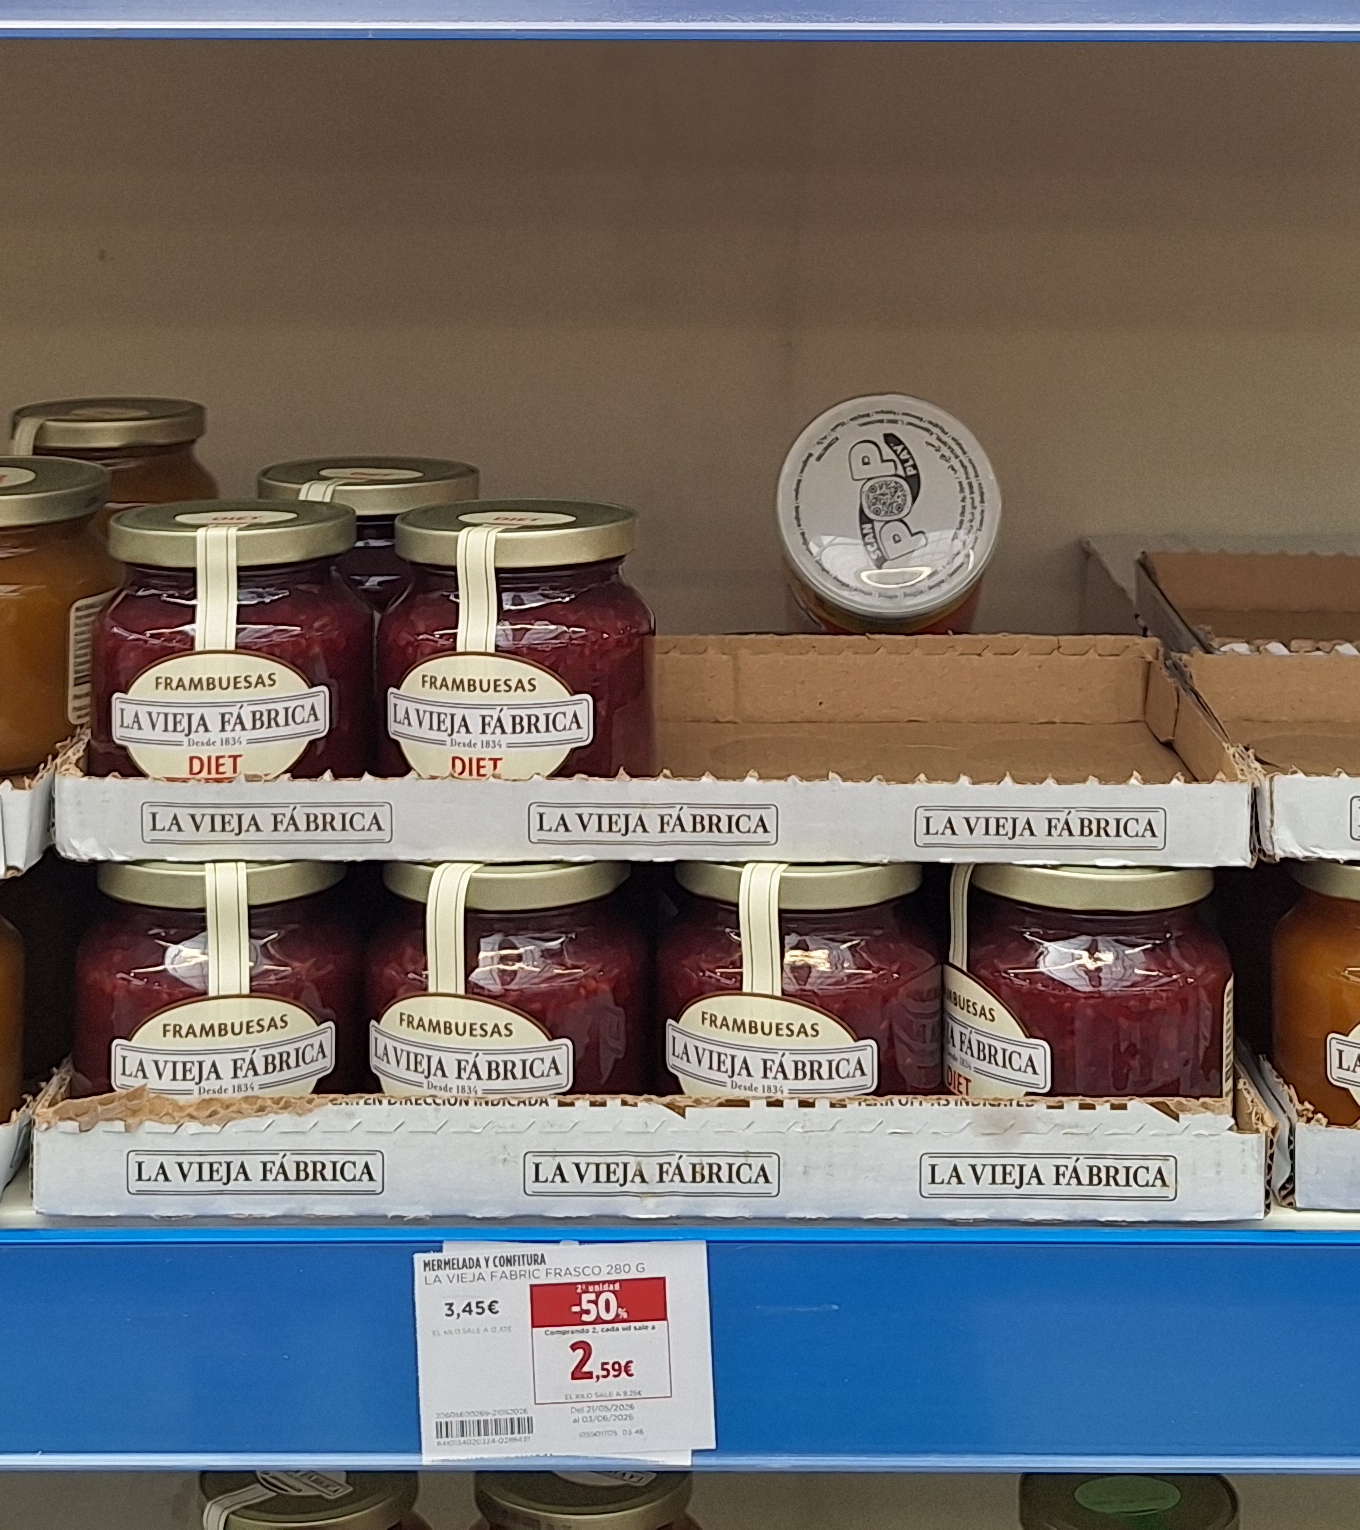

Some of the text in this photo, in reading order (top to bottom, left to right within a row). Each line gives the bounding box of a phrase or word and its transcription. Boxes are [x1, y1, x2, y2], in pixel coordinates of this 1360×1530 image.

[156, 673, 276, 691] FRAMBUESAS
[119, 702, 320, 736] LA VIEJA FÁBRICA
[187, 736, 243, 747] Desde 1834
[188, 754, 242, 776] DIET
[422, 1252, 545, 1270] MERMELADA Y CONFITURA
[424, 1262, 645, 1284] LA VIEJA FABRIC FRASCO 280 G
[443, 1299, 499, 1318] 3,45€
[568, 1340, 633, 1382] 2,59€
